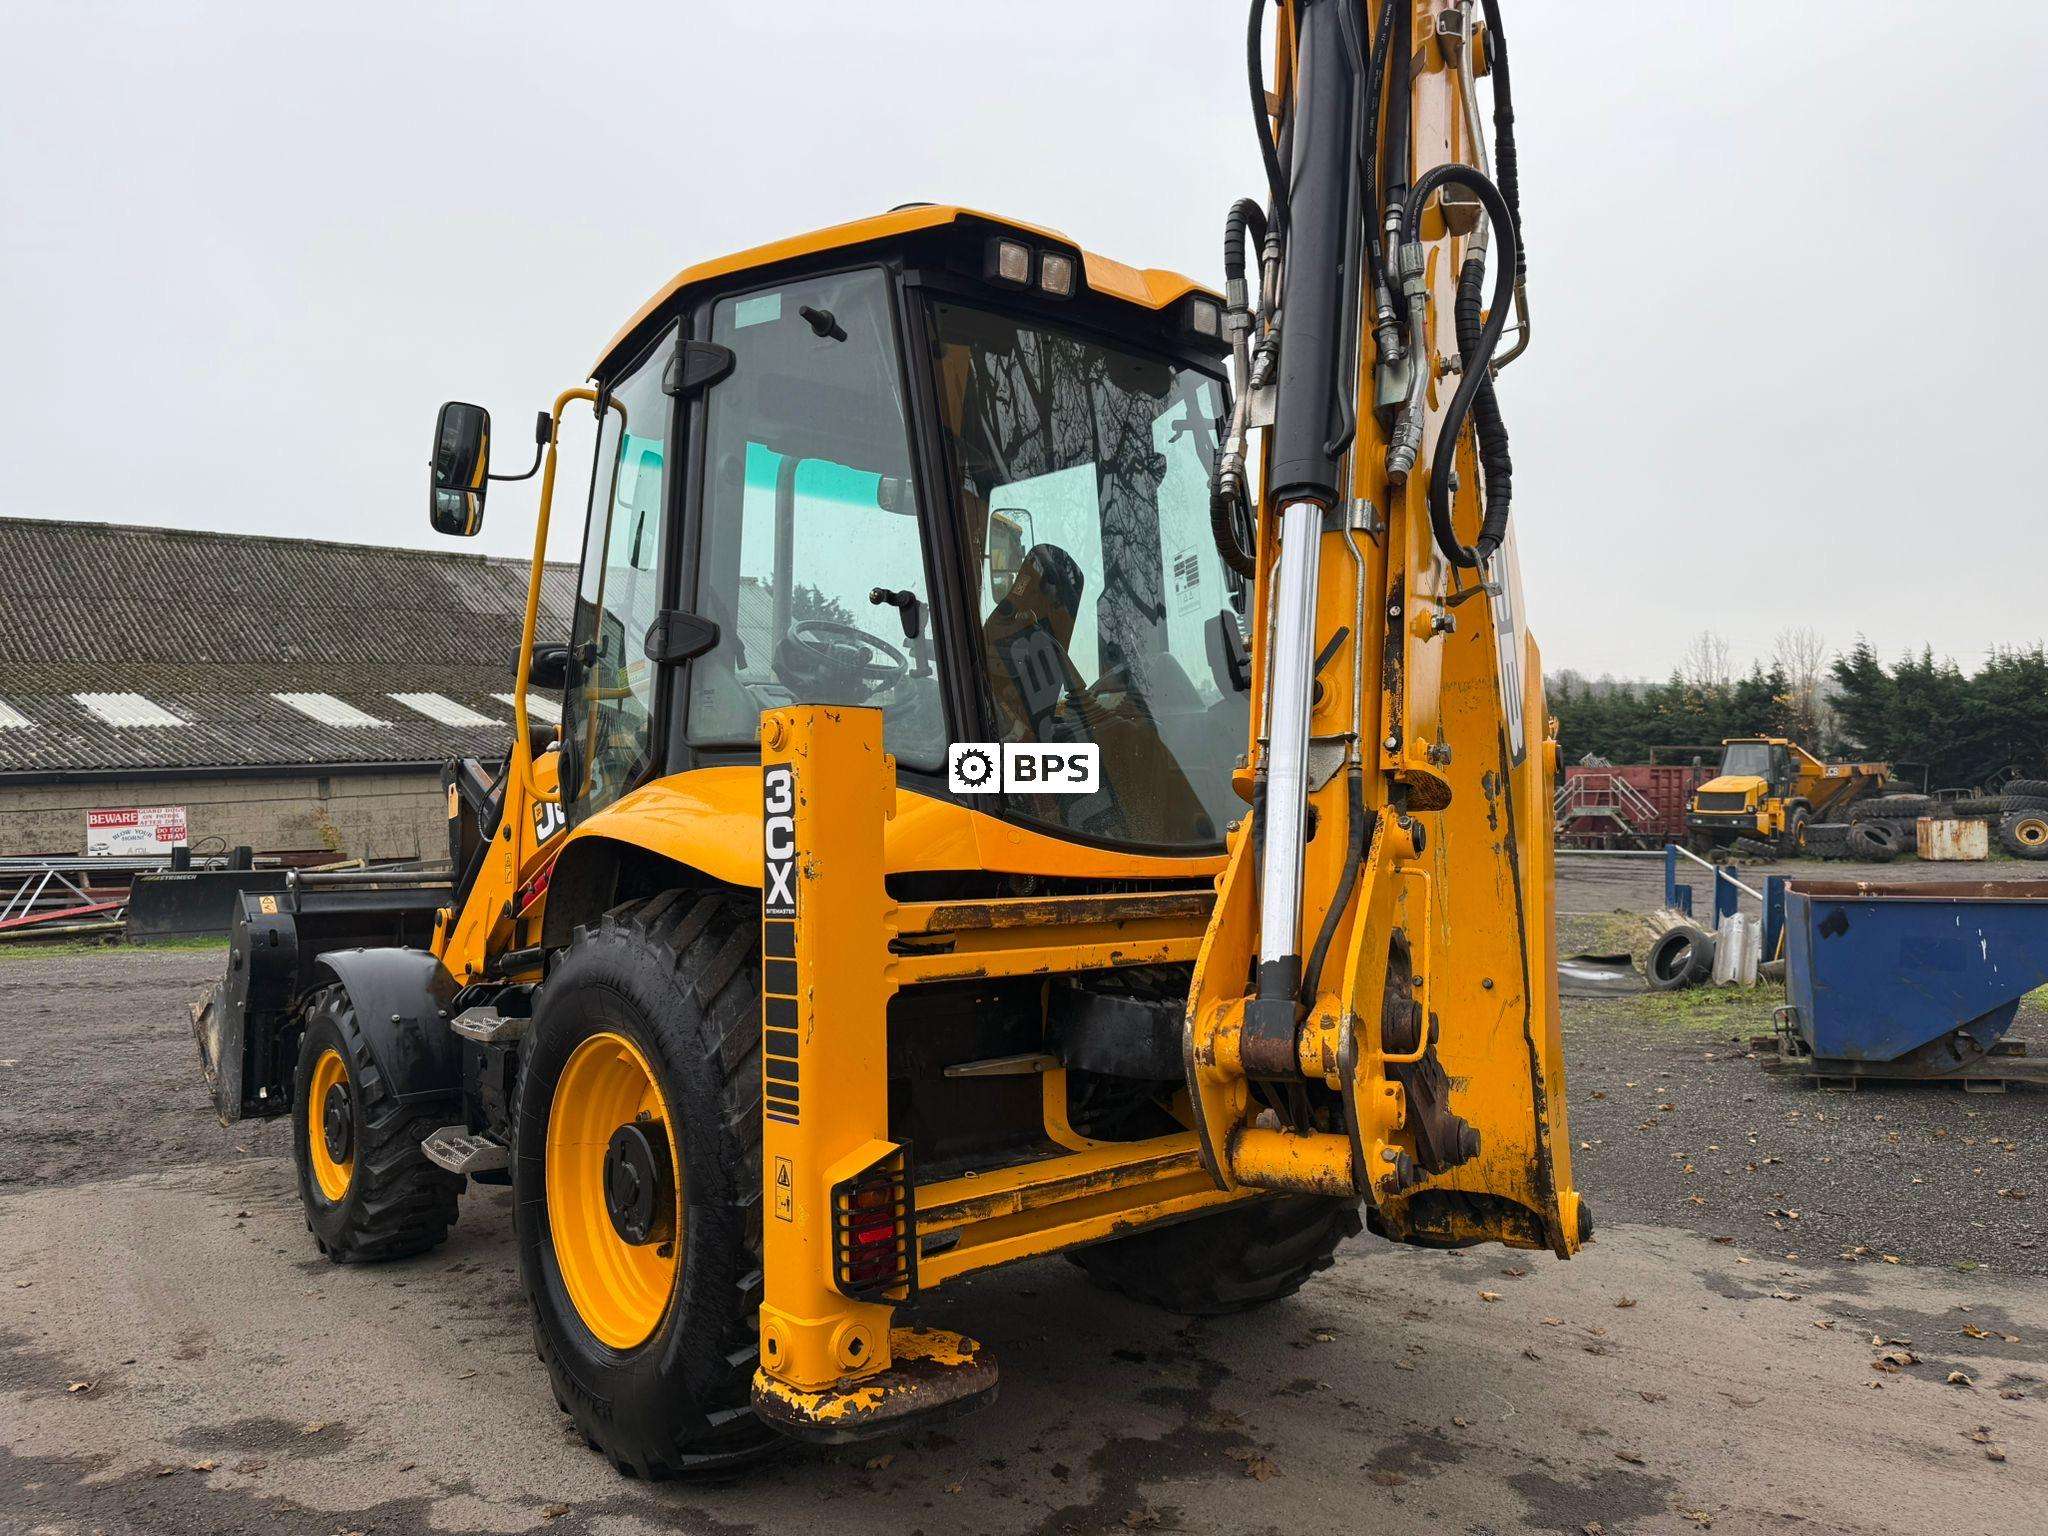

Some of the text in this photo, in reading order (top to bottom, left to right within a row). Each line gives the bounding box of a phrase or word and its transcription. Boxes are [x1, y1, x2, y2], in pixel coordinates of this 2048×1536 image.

[89, 812, 137, 825] BEWARE
[112, 829, 153, 840] BLOW YOUR
[766, 769, 794, 904] 3CX
